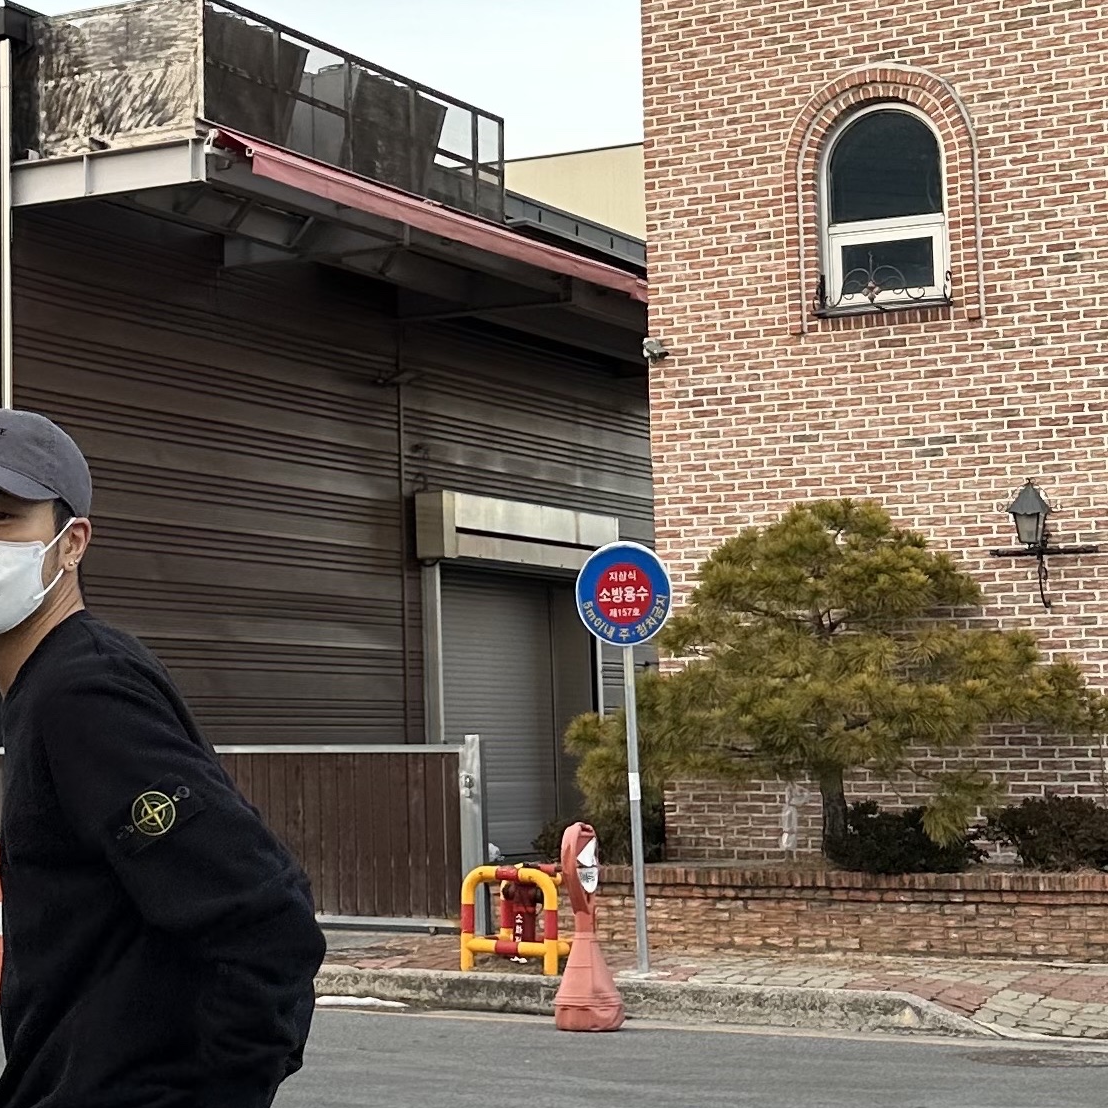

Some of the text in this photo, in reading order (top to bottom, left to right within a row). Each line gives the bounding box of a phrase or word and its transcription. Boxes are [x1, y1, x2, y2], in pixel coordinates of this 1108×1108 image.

[608, 570, 637, 582] 지상식
[598, 585, 649, 604] 소방용수
[583, 601, 616, 639] 5m이내
[609, 607, 641, 618] 제157호
